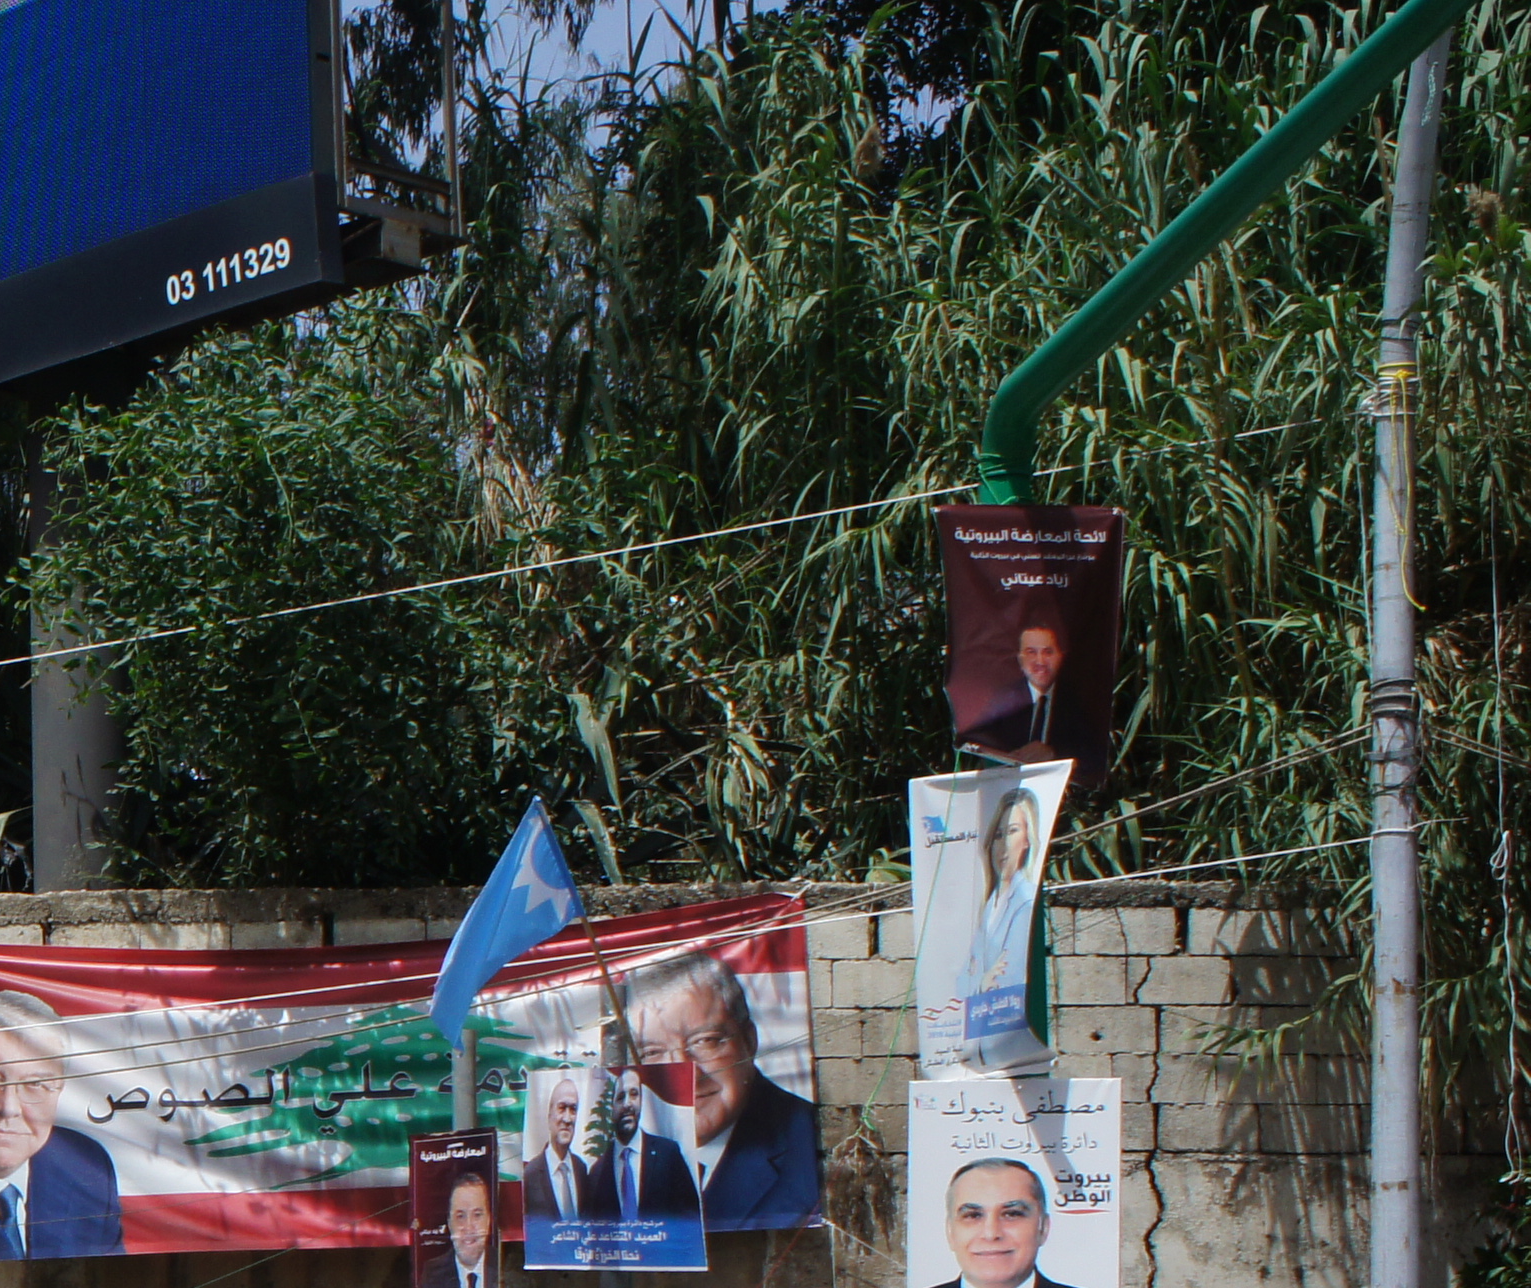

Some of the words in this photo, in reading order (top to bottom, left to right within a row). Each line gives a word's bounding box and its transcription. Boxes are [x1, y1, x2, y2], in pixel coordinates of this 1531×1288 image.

[166, 270, 196, 305] 03
[202, 238, 291, 292] 111329
[954, 527, 1009, 544] البيروتية
[1011, 528, 1071, 544] المعارضة
[1073, 528, 1107, 544] لائحة
[1000, 572, 1043, 590] عيتاني
[1045, 573, 1068, 588] زياد
[86, 1064, 292, 1124] الصوص
[313, 1060, 417, 1135] علي
[941, 1091, 1004, 1123] بنبوك
[1012, 1090, 1105, 1125] مصطفى
[950, 1132, 996, 1155] الثانية
[1000, 1138, 1058, 1155] بيروت
[1061, 1132, 1098, 1154] دائرة
[1054, 1168, 1112, 1188] بيروت
[1054, 1188, 1111, 1208] الوطن
[551, 1229, 580, 1245] الشاعر
[634, 1230, 668, 1245] العميد
